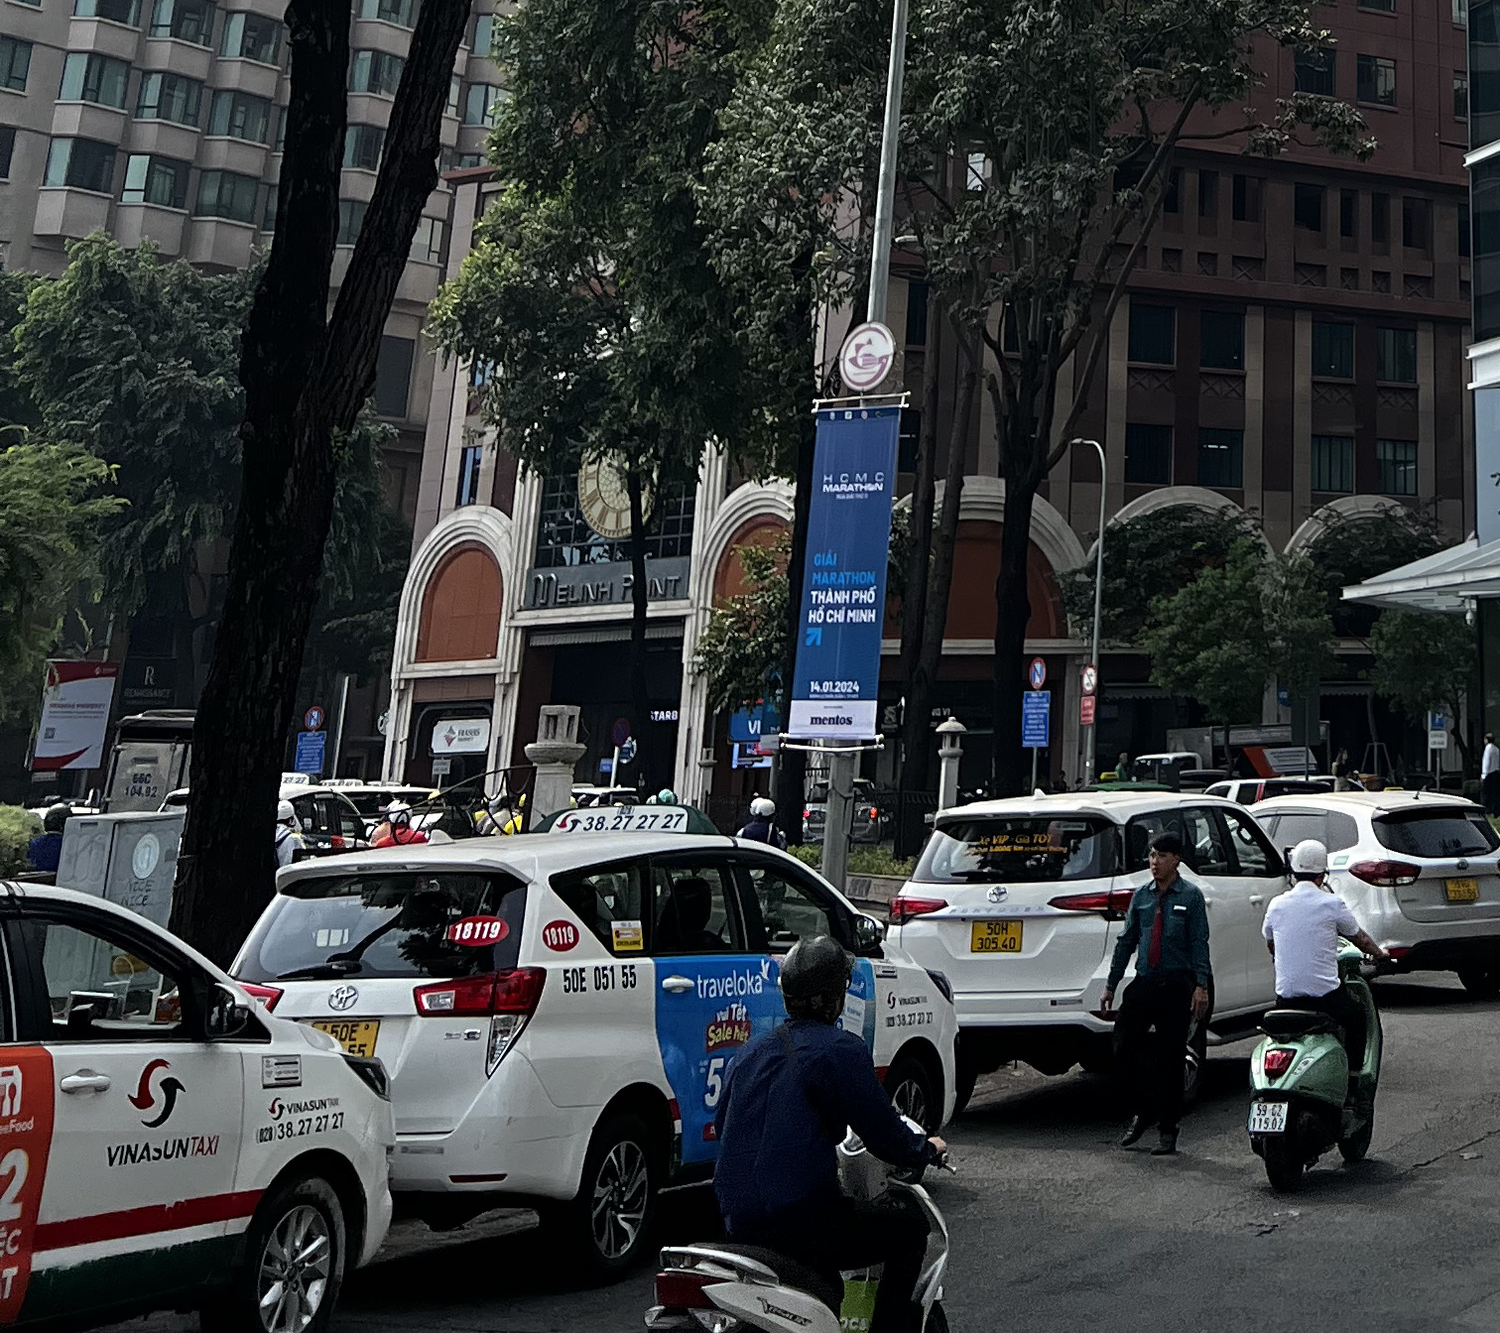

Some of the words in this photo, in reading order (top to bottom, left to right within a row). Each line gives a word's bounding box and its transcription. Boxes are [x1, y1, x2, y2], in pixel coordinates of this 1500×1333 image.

[822, 482, 884, 493] MARATHON
[811, 570, 876, 585] MARATHON
[810, 587, 850, 604] THÀNH
[851, 585, 877, 604] PHỐ
[825, 606, 846, 623] CHÍ
[846, 609, 876, 623] MINH
[809, 680, 860, 693] 14.01.2024
[809, 714, 853, 726] mentos
[583, 815, 634, 832] 38.27
[635, 814, 660, 831] 27
[660, 813, 686, 829] 27
[455, 921, 501, 941] 18119
[544, 925, 574, 946] 18119
[986, 922, 1008, 935] 50H
[563, 968, 587, 994] 50E
[593, 965, 616, 991] 051
[621, 964, 637, 989] 55
[696, 969, 763, 1000] traveloka
[707, 1023, 733, 1047] Sale
[277, 1117, 313, 1140] 38.27
[314, 1115, 330, 1134] 27
[331, 1112, 346, 1131] 27
